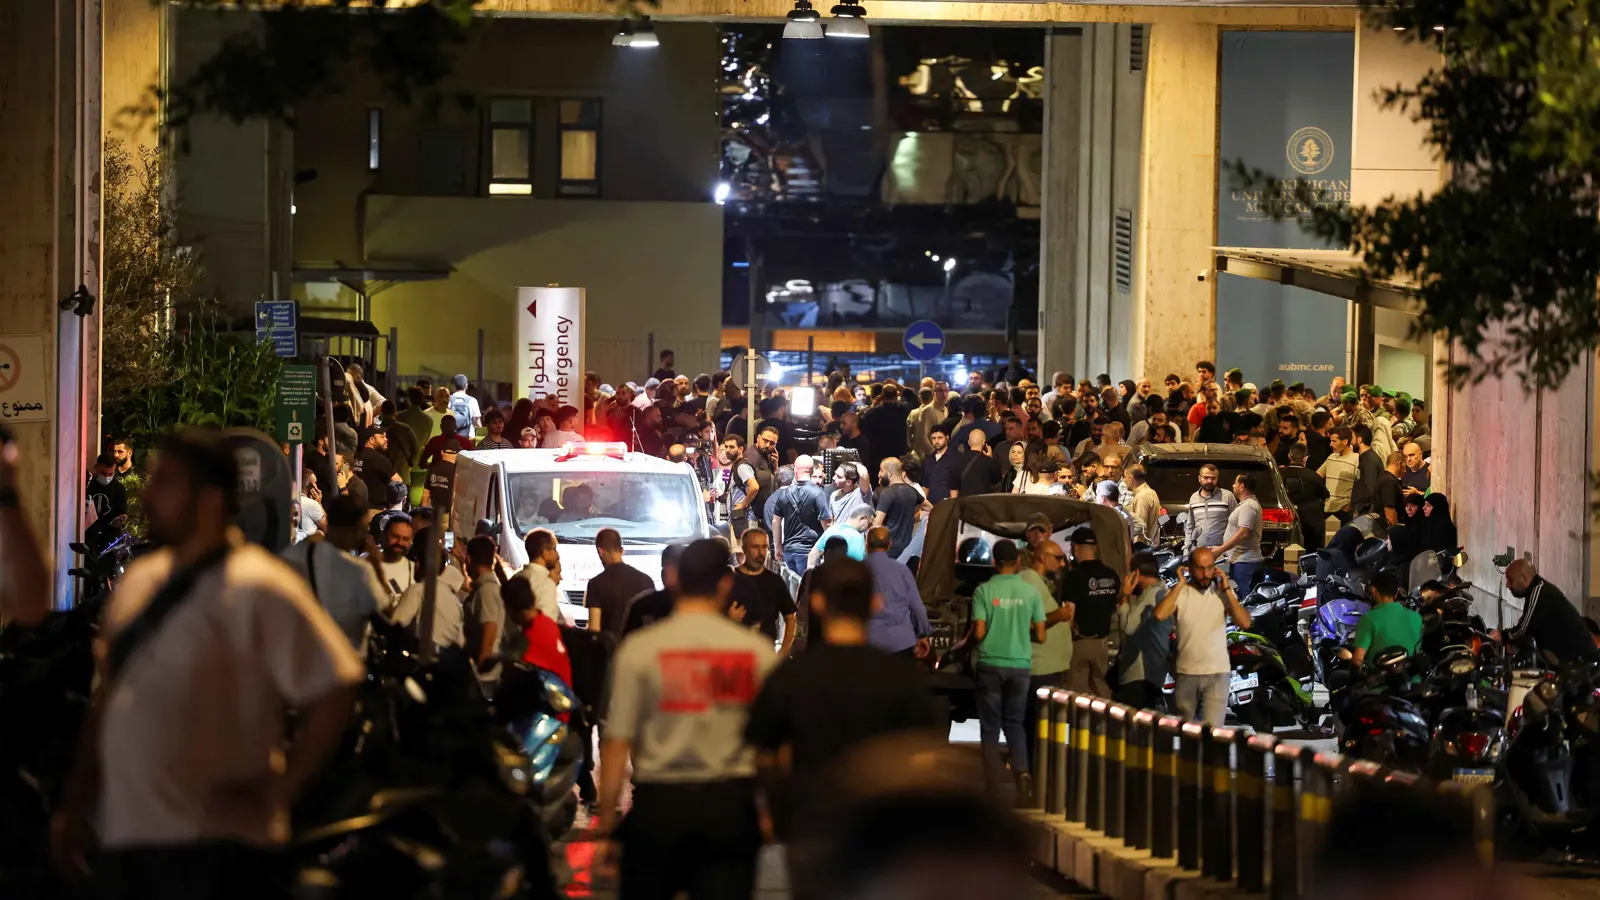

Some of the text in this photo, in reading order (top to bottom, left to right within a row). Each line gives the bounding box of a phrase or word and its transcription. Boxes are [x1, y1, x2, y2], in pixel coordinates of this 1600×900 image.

[1280, 180, 1349, 190] MICAN
[556, 316, 573, 406] mergency
[1279, 362, 1334, 371] aubmc.care
[528, 343, 549, 401] الطوار
[2, 400, 43, 417] ممنوع
